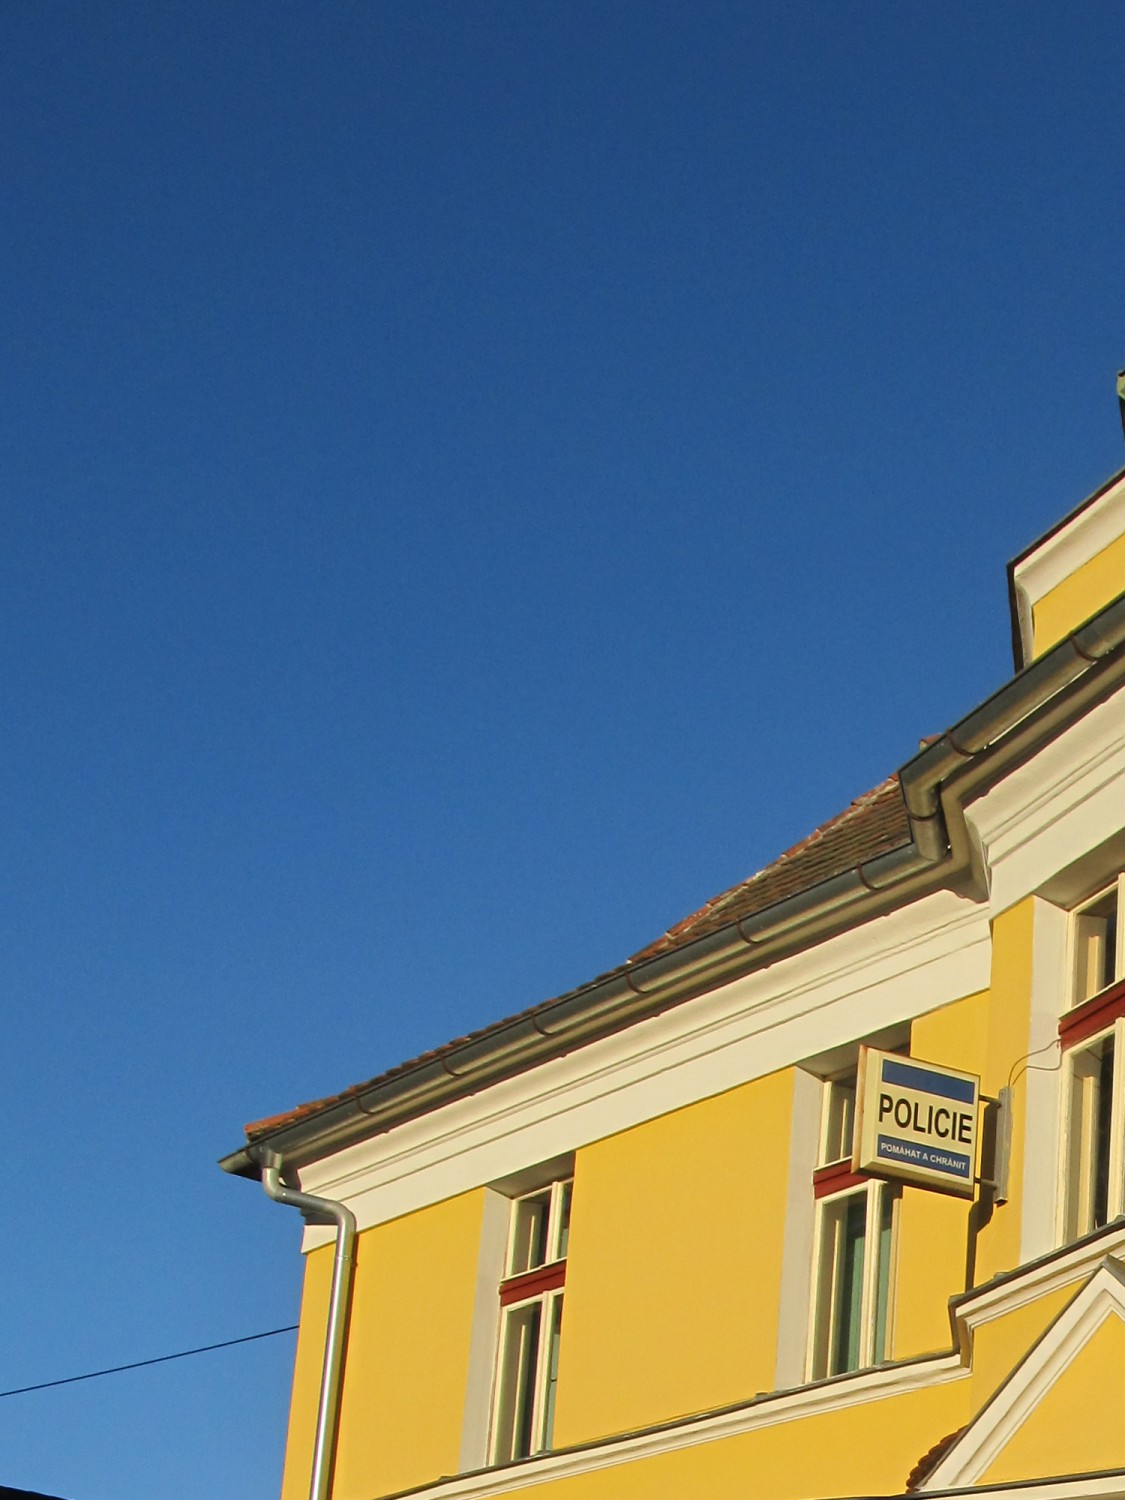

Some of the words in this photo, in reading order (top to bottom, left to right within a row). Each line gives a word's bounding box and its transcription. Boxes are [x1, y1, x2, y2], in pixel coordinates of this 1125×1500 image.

[878, 1093, 973, 1144] POLICIE
[881, 1142, 921, 1159] POMÁHAT
[922, 1153, 929, 1161] A
[930, 1154, 967, 1170] CHRÁNIT
